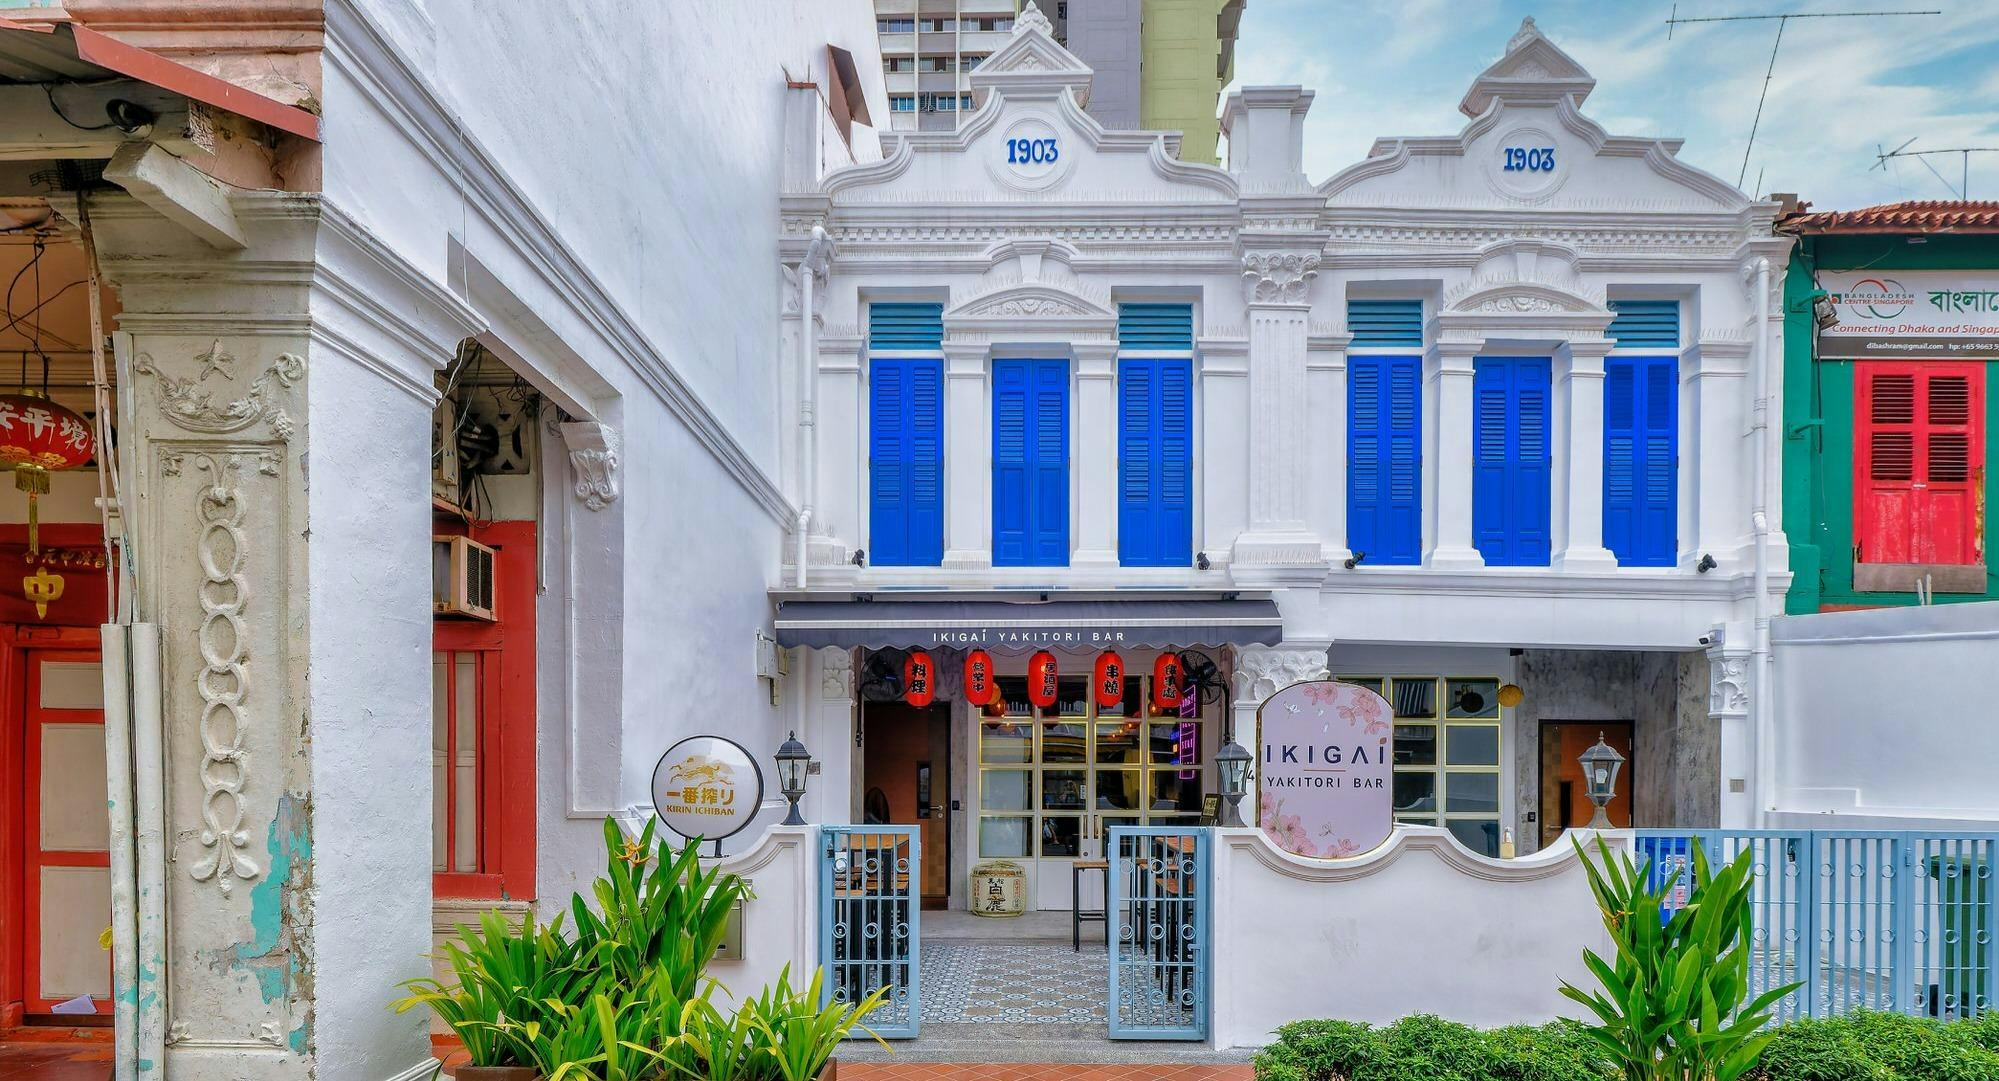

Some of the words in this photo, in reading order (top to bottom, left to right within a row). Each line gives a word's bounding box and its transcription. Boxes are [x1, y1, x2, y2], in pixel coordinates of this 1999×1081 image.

[1007, 138, 1058, 164] 1903
[1504, 147, 1555, 172] 1903
[1832, 325, 1896, 335] Connecting
[1898, 324, 1935, 333] Dhaka
[1937, 324, 1960, 333] and
[1866, 342, 1944, 351] dibashram@gmail.com
[999, 632, 1081, 642] YAKITORI
[1092, 632, 1124, 641] BAR
[1043, 662, 1056, 697] 居酒屋
[1267, 776, 1340, 788] YAKITORI
[1353, 777, 1384, 789] BAR
[666, 786, 734, 806] 一番搾り
[666, 804, 692, 814] KIRIN
[695, 806, 735, 816] ICHIBAN
